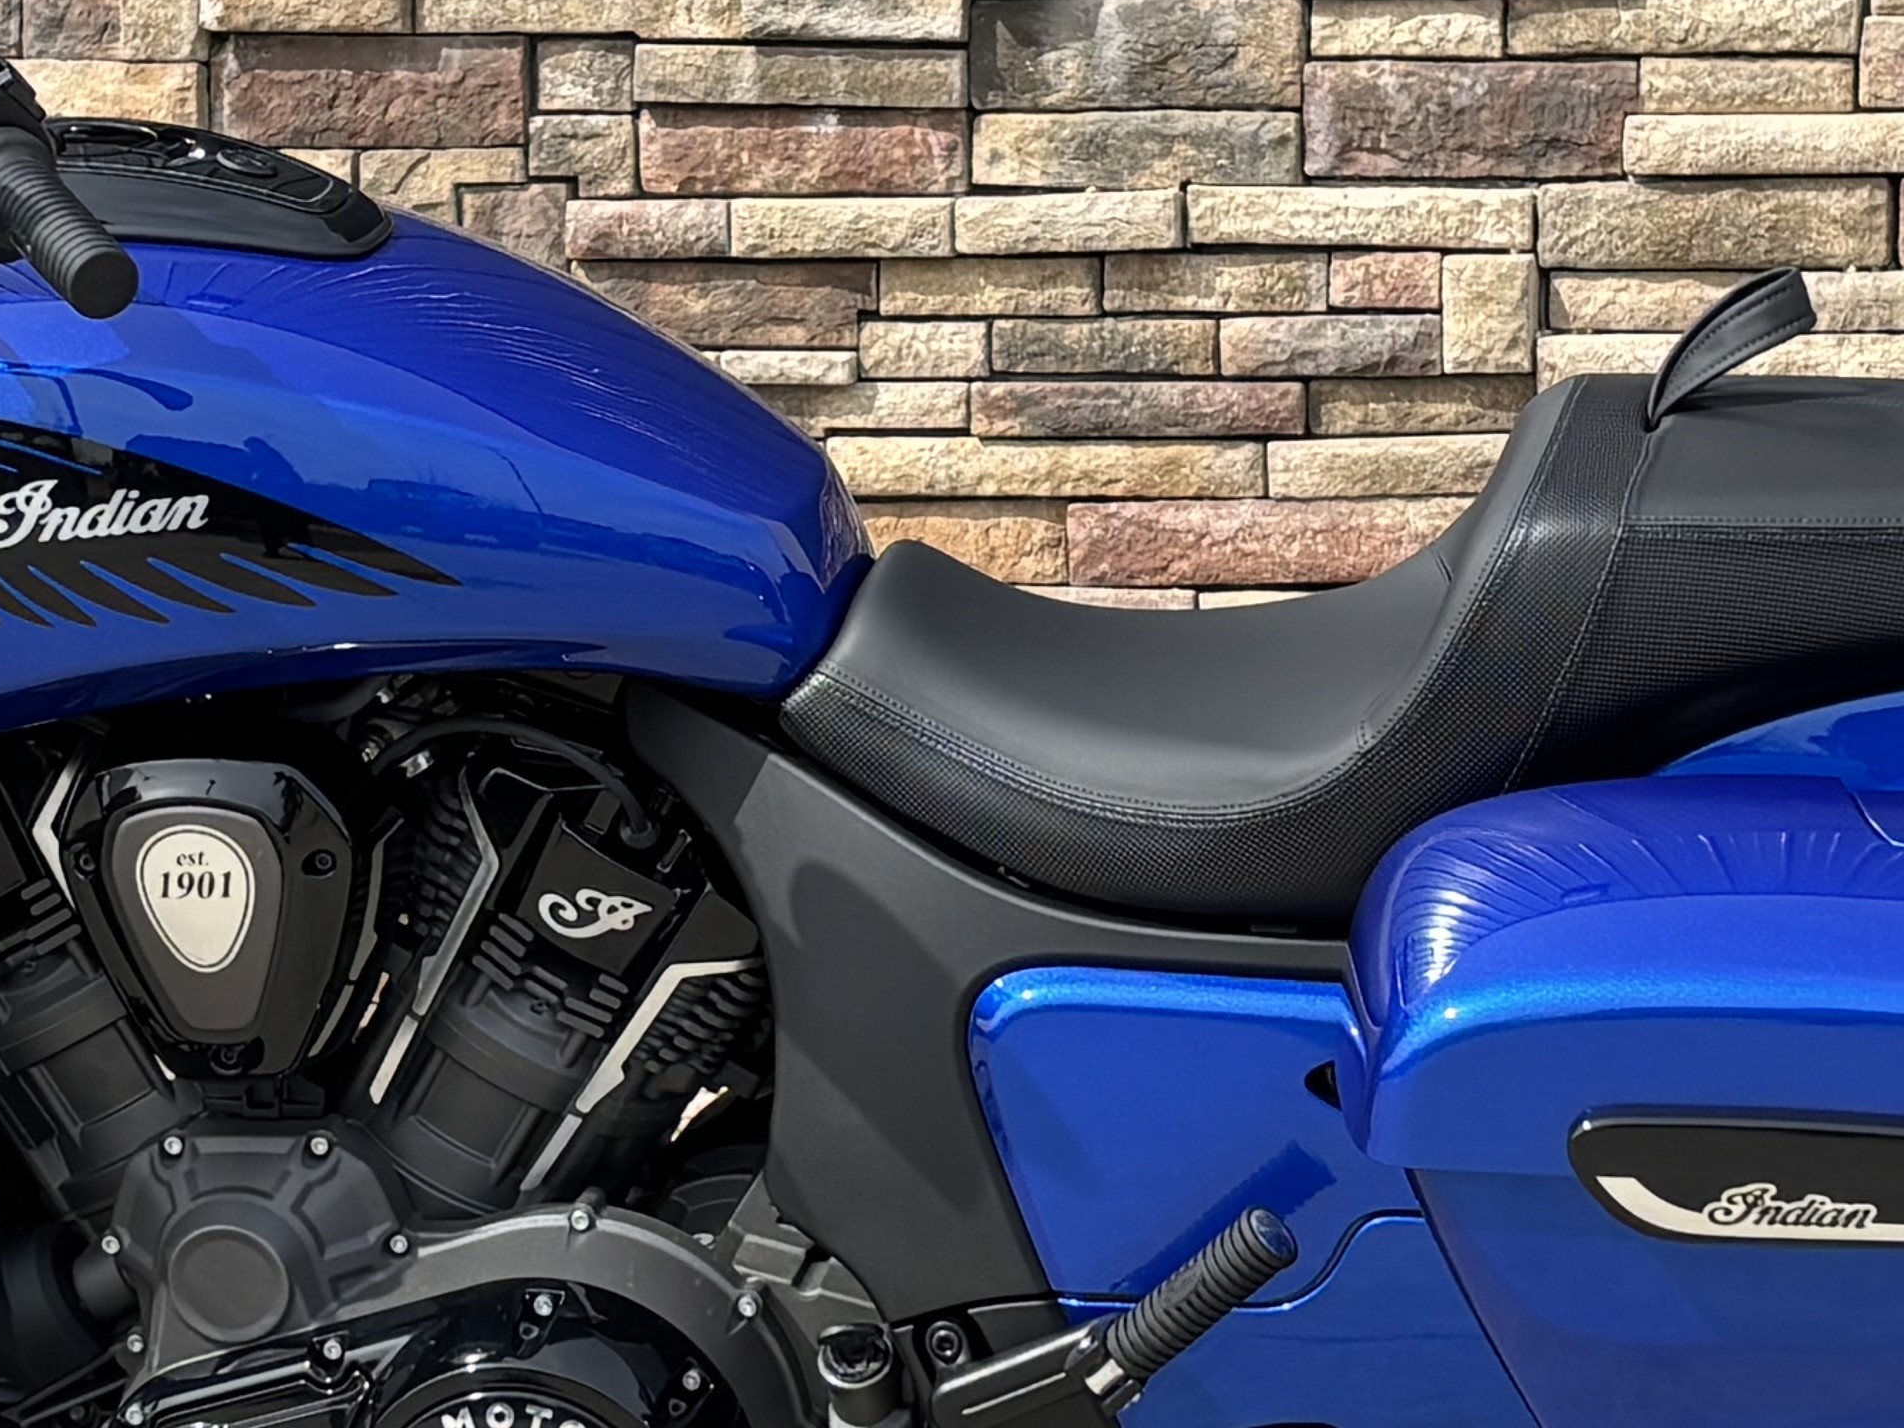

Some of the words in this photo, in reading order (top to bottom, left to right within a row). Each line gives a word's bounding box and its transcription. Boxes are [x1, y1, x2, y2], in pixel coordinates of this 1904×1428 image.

[176, 852, 209, 867] est.
[160, 870, 232, 899] 1901
[1706, 1185, 1873, 1229] Indian
